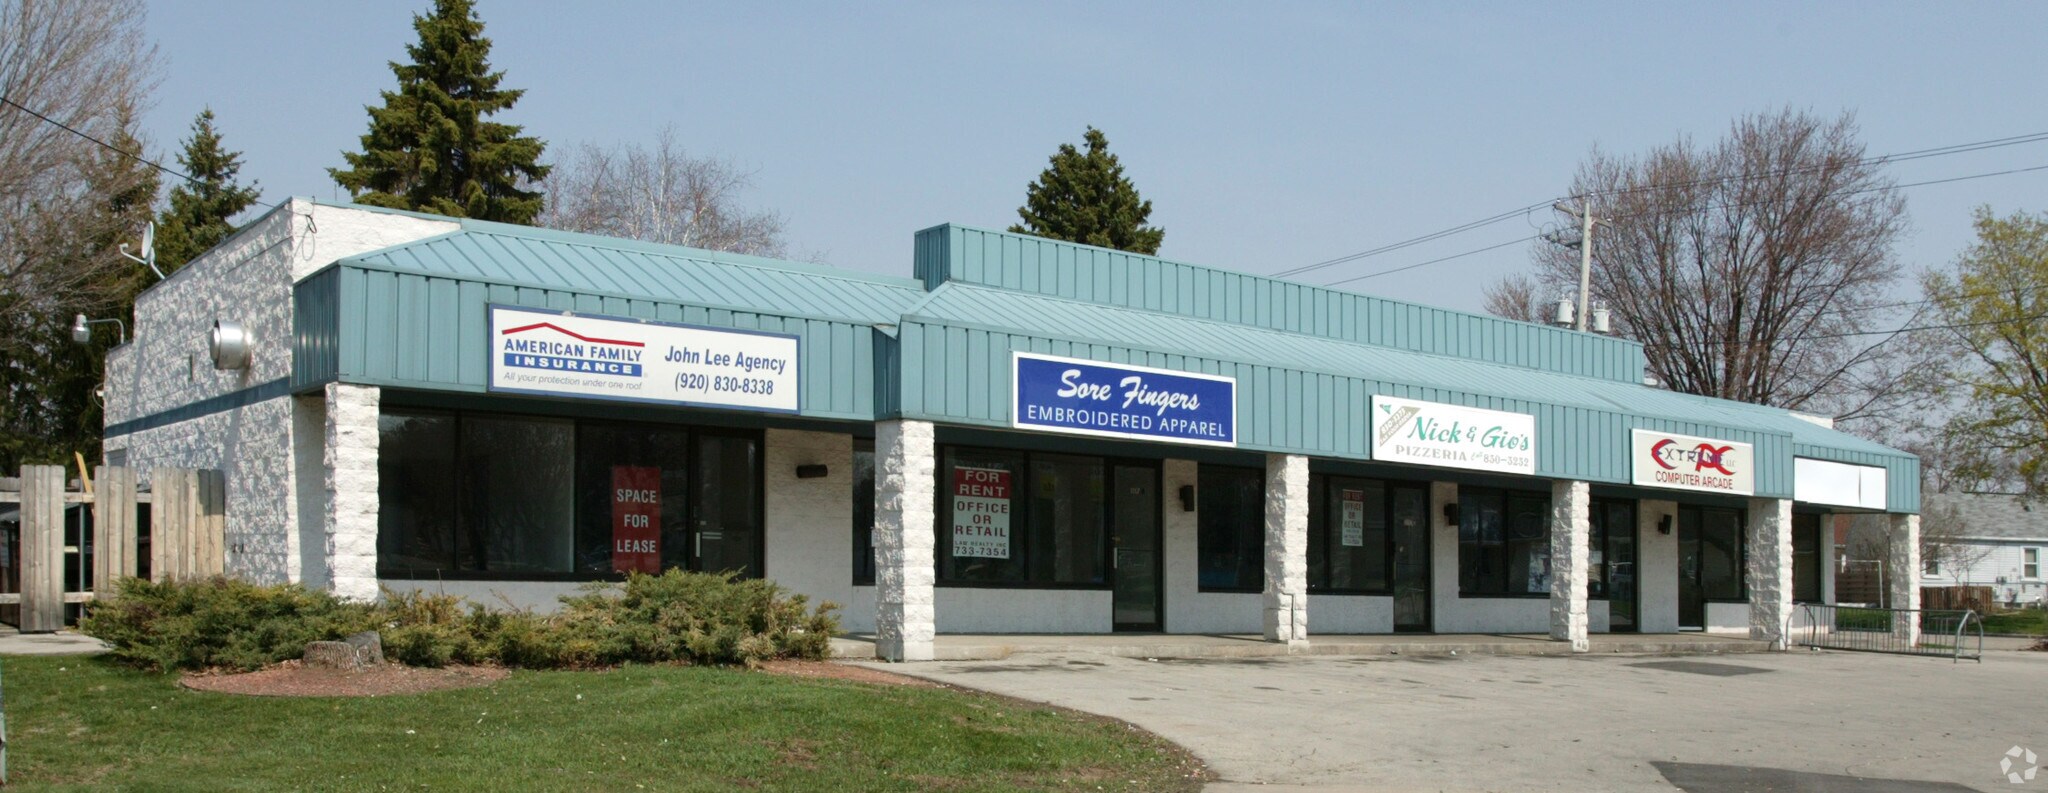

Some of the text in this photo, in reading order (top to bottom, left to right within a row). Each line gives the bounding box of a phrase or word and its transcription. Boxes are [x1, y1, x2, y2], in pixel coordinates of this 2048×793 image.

[504, 339, 642, 362] AMERICAN FAMILY
[514, 356, 633, 374] INSURANCE
[664, 345, 786, 375] John Lee Agency
[517, 374, 536, 383] your
[538, 375, 580, 386] protection
[582, 379, 606, 387] under
[626, 382, 642, 390] roof
[675, 372, 774, 395] (920) 830-8338
[1057, 369, 1201, 416] Sore Fingers
[1027, 404, 1226, 437] EMBROIDERED APPAREL
[1407, 416, 1462, 444] Nick
[1466, 426, 1477, 443] &
[1481, 426, 1529, 451] Gio's
[1395, 444, 1467, 461] PIZZERIA
[965, 470, 1000, 483] FOR
[1655, 470, 1734, 490] COMPUTER ARCADE
[616, 489, 657, 503] SPACE
[960, 484, 1005, 497] RENT
[956, 501, 1009, 514] OFFICE
[624, 514, 649, 528] FOR
[972, 514, 992, 525] OR
[955, 525, 1007, 537] RETAIL
[616, 540, 657, 553] LEASE
[955, 546, 1007, 556] 733-7354
